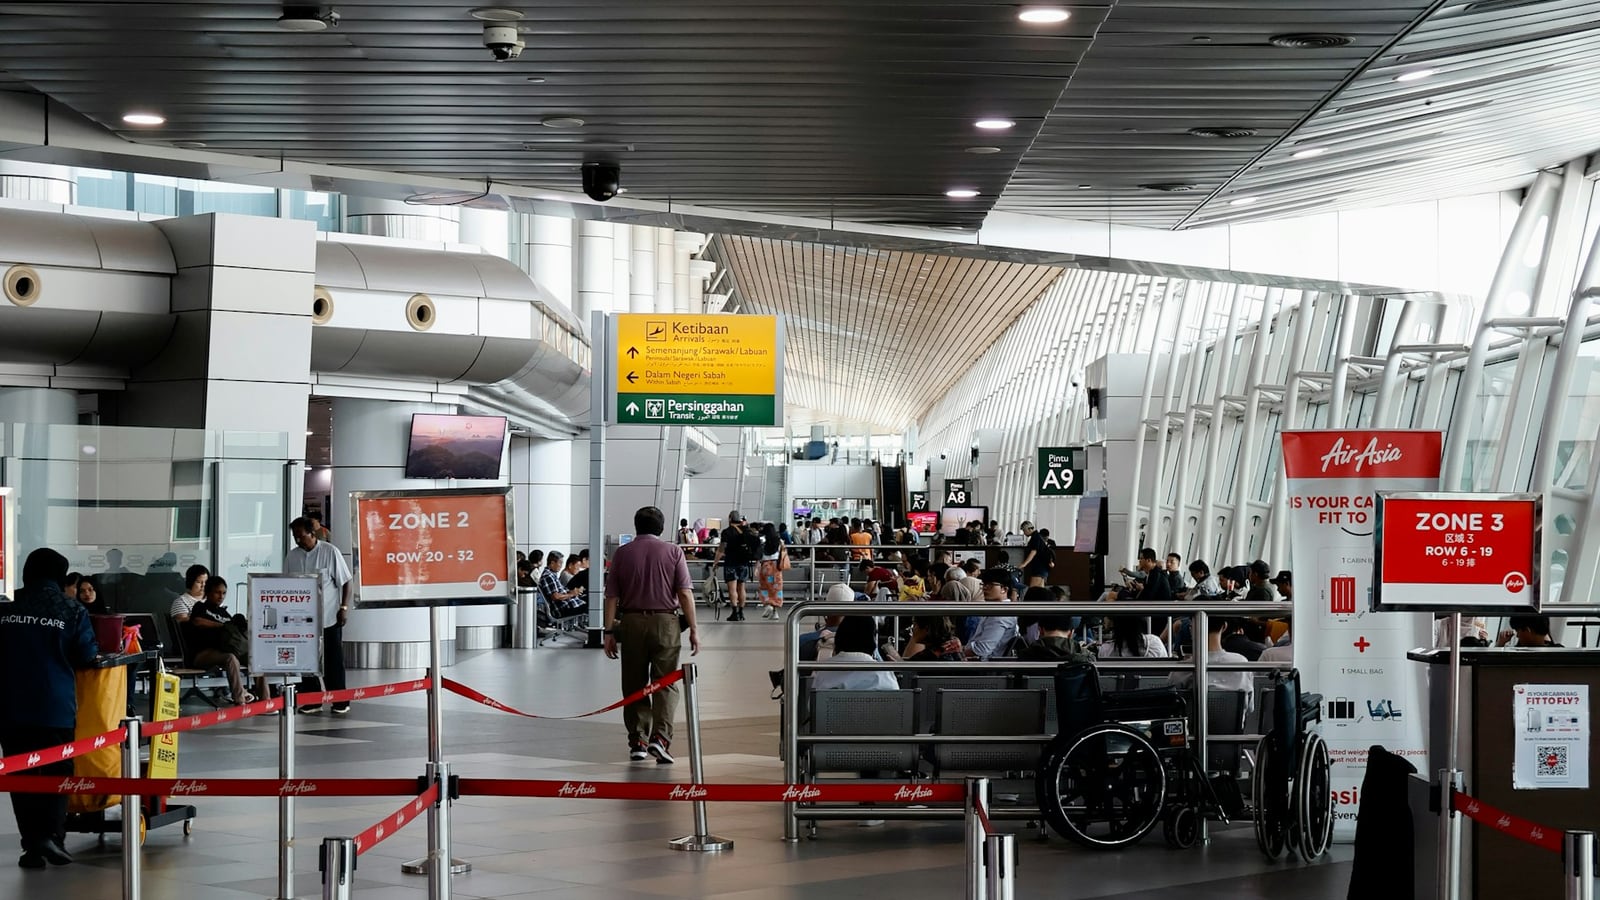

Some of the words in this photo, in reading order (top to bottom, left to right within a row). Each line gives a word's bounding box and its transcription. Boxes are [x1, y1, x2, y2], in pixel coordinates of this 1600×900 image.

[672, 321, 729, 335] Ketibaan
[673, 335, 705, 343] Arrivals
[645, 370, 670, 379] Dalam
[673, 371, 701, 381] Negeri
[703, 371, 726, 379] Sabah
[668, 400, 744, 415] Persinggahan
[669, 411, 695, 420] Transit
[1049, 454, 1069, 462] Pintu
[1042, 468, 1074, 490] A9
[947, 491, 966, 504] A8
[1290, 497, 1302, 508] IS
[1306, 497, 1349, 508] YOUR
[1353, 497, 1373, 508] CA
[912, 500, 926, 510] A7
[388, 512, 450, 530] ZONE
[457, 511, 469, 528] 2
[1319, 512, 1342, 524] FIT
[1347, 512, 1367, 524] TO
[1415, 512, 1483, 531] ZONE
[1490, 513, 1504, 531] 3
[1467, 533, 1474, 544] 3
[386, 552, 421, 563] ROW
[425, 551, 444, 562] 20
[457, 550, 474, 561] 32
[1425, 546, 1457, 556] ROW
[1460, 546, 1468, 556] 6
[1479, 547, 1493, 557] 19
[1442, 558, 1448, 566] 6
[260, 595, 276, 603] FIT
[276, 595, 289, 603] TO
[1, 614, 39, 625] FACILITY
[40, 617, 65, 630] CARE
[1526, 697, 1542, 705] FIT
[1543, 697, 1554, 705] TO
